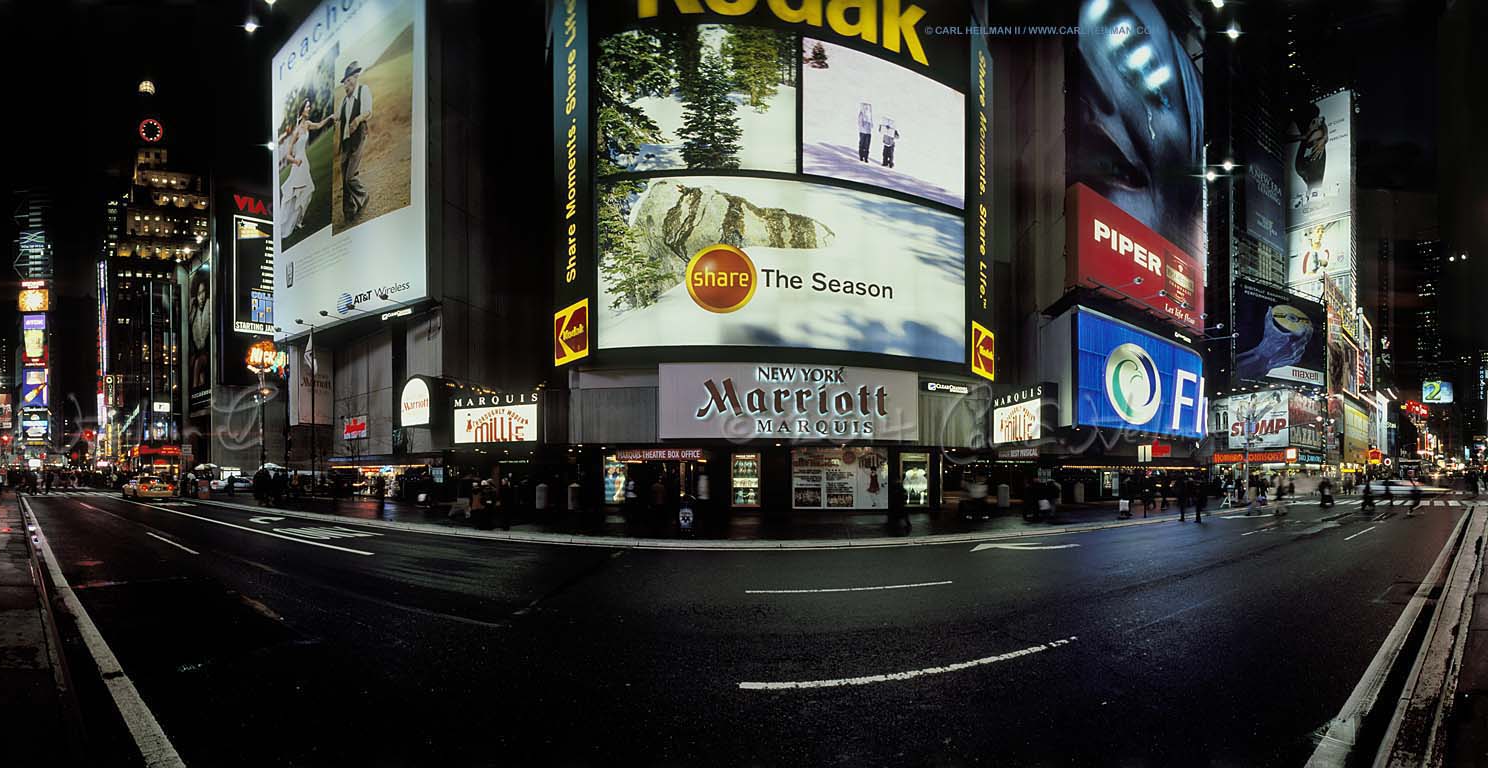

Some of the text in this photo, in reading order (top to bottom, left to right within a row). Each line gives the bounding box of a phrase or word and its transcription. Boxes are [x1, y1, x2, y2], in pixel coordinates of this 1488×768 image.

[638, 0, 929, 66] dak
[565, 48, 577, 115] Share
[978, 50, 987, 257] Share Moments. Share
[565, 117, 577, 214] Moments.
[565, 222, 577, 283] Share
[1094, 219, 1162, 277] PIPER
[353, 281, 411, 305] AT&T Wireless
[692, 267, 894, 300] share The Season
[1174, 307, 1183, 320] life
[235, 321, 264, 331] STARTING
[562, 324, 585, 342] Kodak
[757, 366, 845, 384] NEW YORK
[1292, 369, 1319, 380] maxell
[454, 393, 538, 407] MARQUIS
[695, 377, 889, 419] Marriott
[994, 385, 1043, 407] MARQUIS
[1424, 381, 1441, 400] 2
[403, 398, 429, 412] Marriott
[507, 409, 529, 425] MODERN
[756, 418, 874, 435] MARQUIS
[642, 450, 666, 459] THEATRE
[667, 450, 679, 458] BOX
[681, 449, 700, 458] OFFICE
